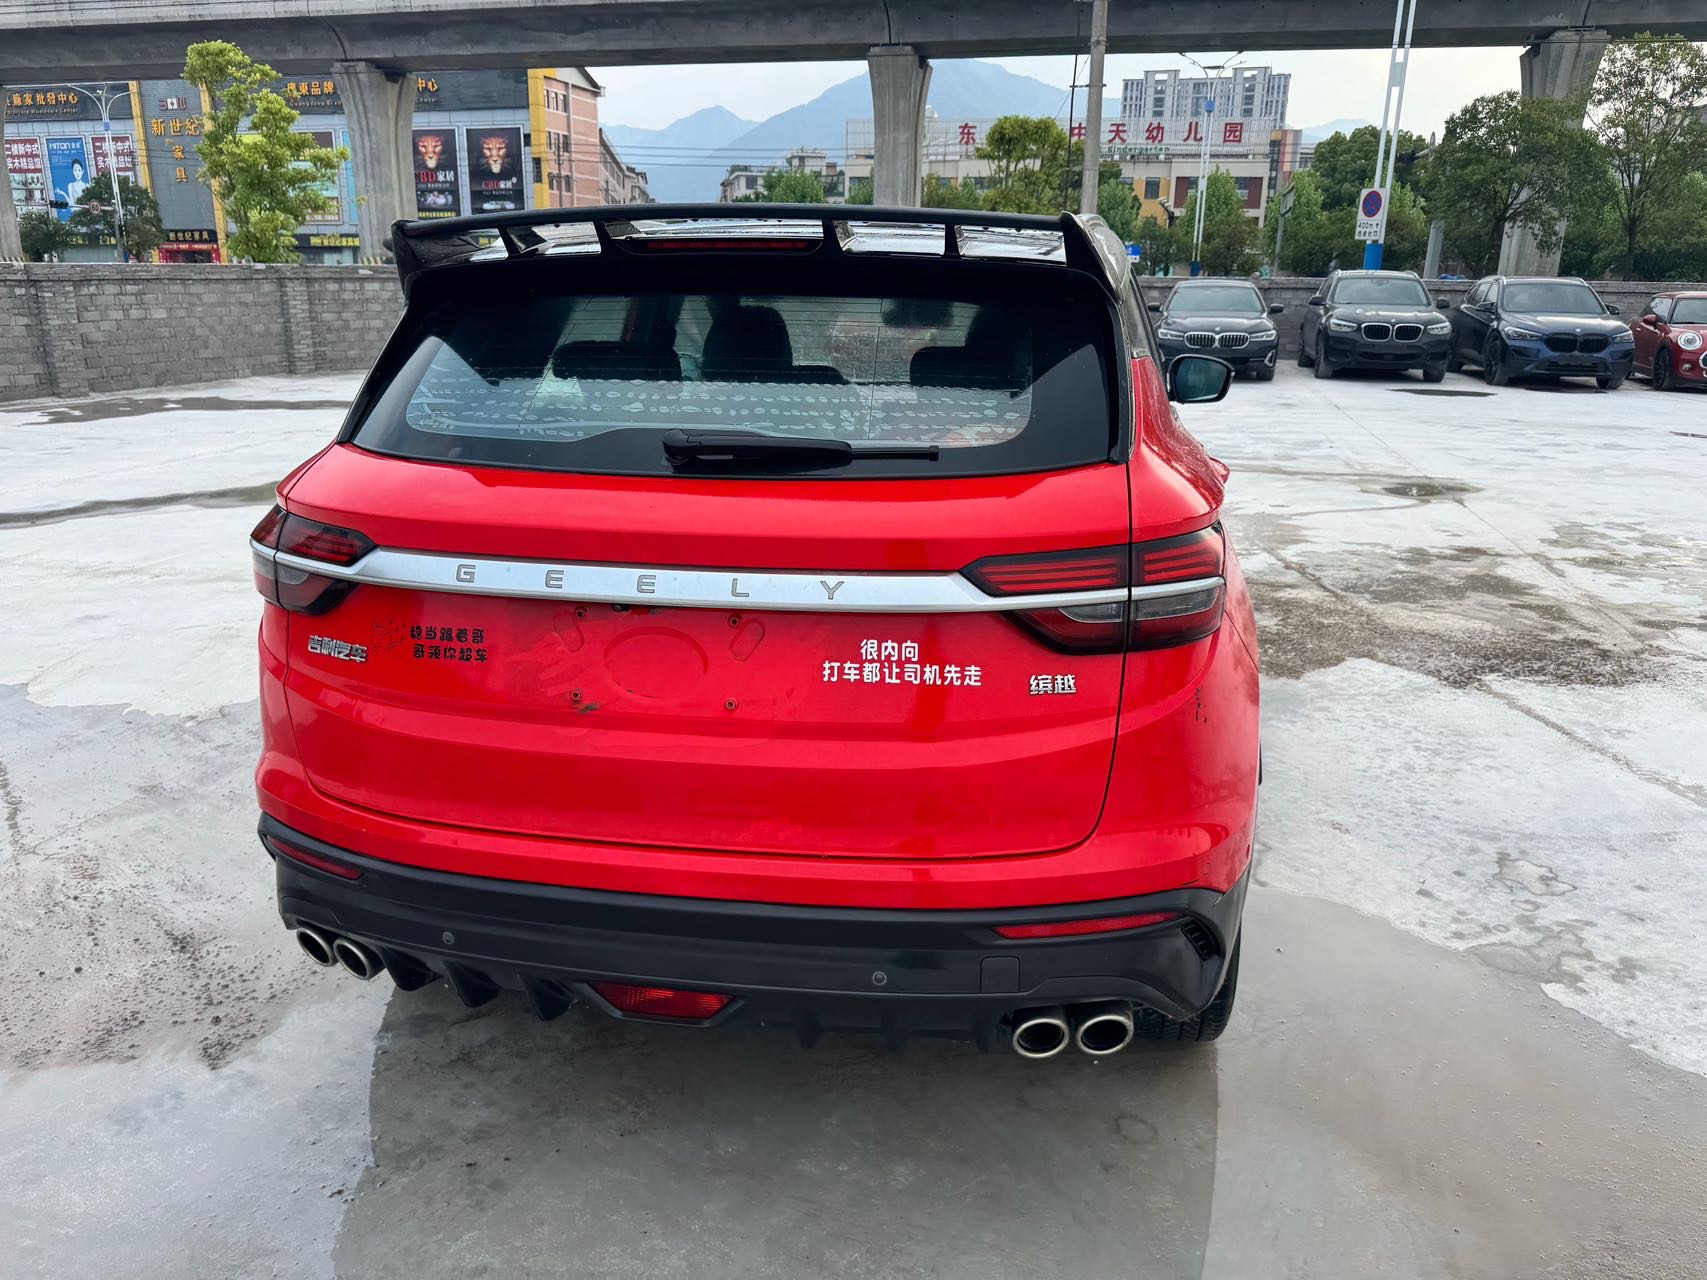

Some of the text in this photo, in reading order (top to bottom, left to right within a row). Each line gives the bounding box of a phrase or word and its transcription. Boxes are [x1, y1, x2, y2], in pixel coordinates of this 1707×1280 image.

[6, 91, 78, 106] 廠家批發中心
[958, 122, 1244, 145] 东中天幼儿园
[1107, 146, 1170, 155] Kindergarten
[455, 563, 845, 601] GEELY
[307, 634, 369, 664] 吉利汽车
[859, 638, 919, 662] 很内向
[822, 660, 982, 687] 打车都让司机先走
[1029, 674, 1077, 696] 缤越
